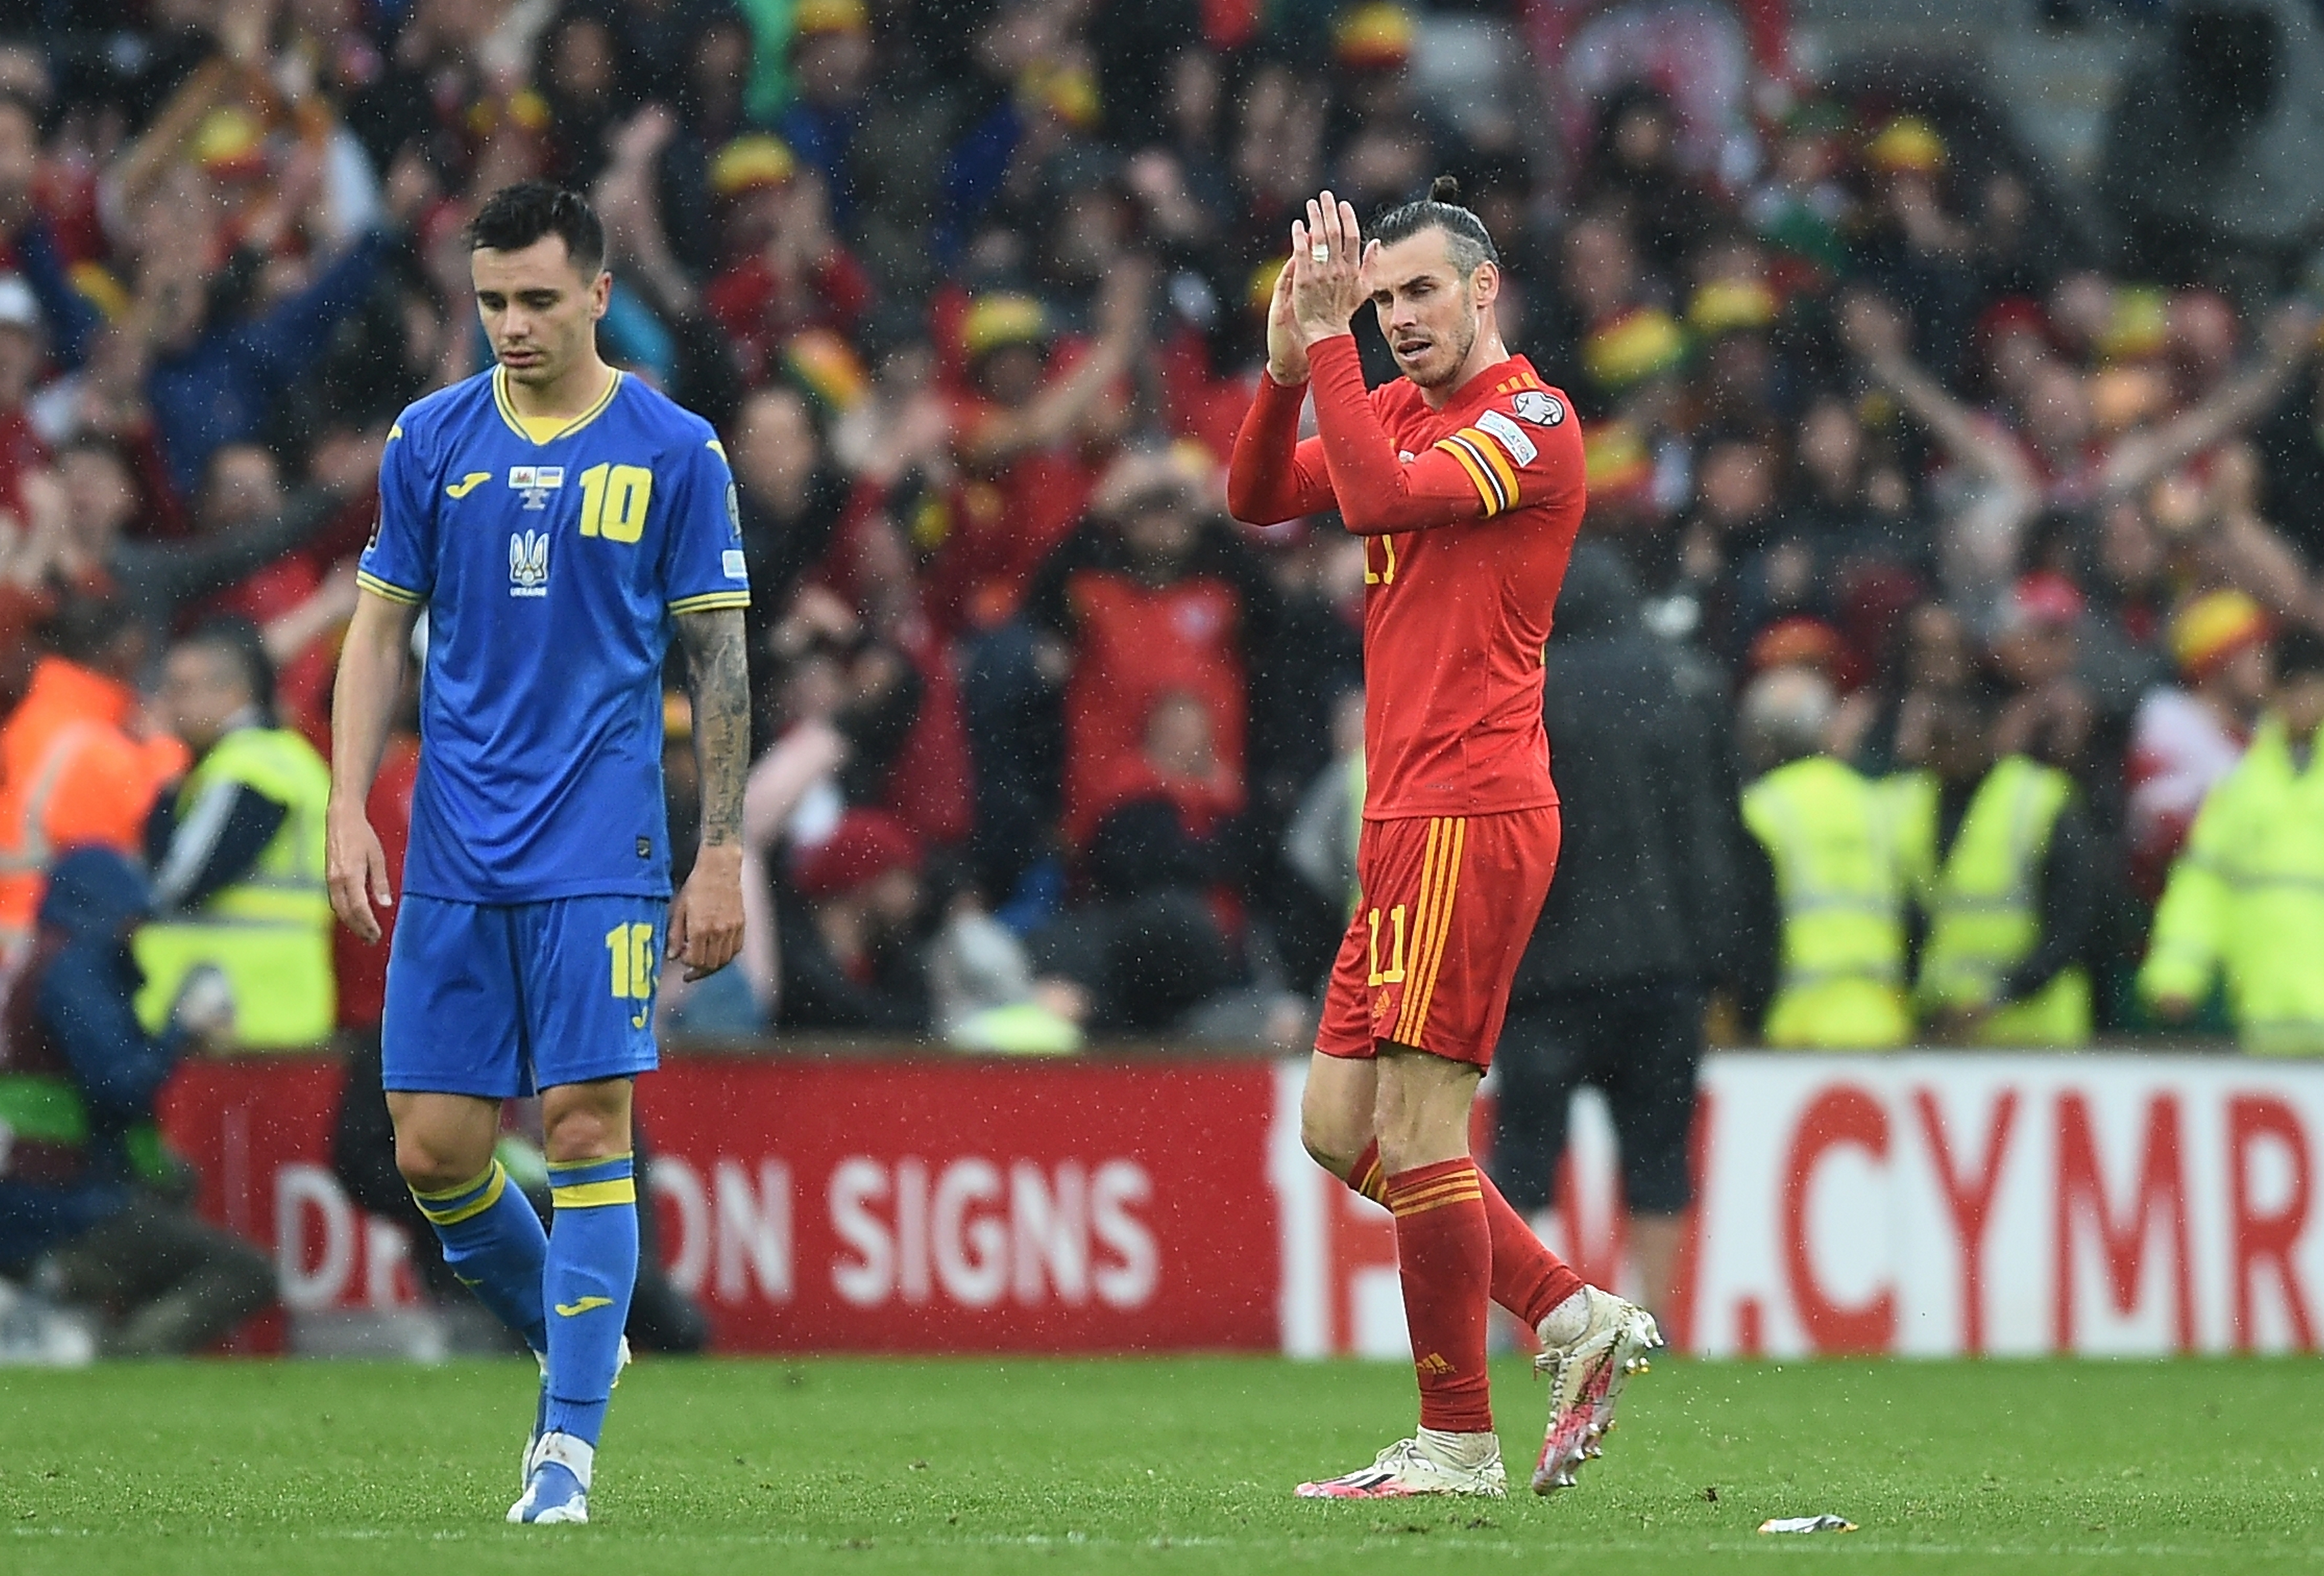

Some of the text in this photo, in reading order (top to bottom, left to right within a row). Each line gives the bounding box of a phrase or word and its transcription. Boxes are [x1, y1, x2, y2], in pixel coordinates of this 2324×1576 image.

[579, 462, 652, 544] 10
[605, 921, 658, 1000] 10
[1369, 904, 1406, 987] 11
[275, 1155, 1160, 1309] DON SIGNS
